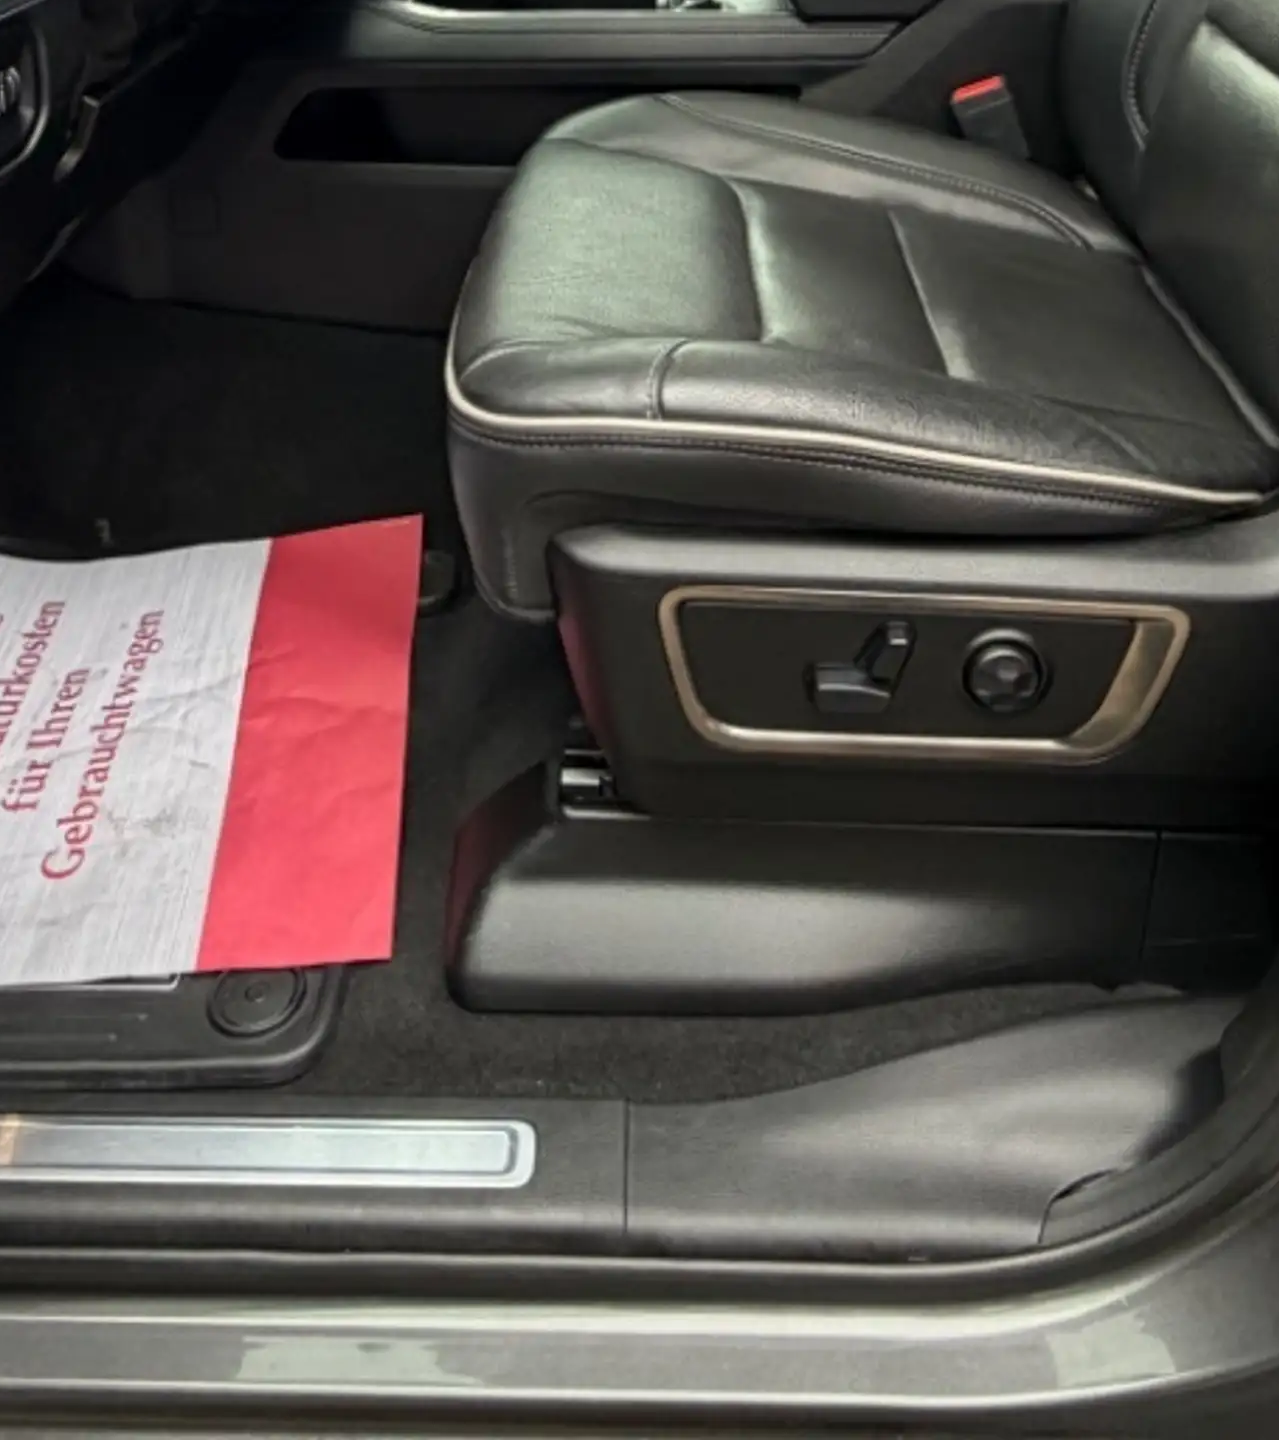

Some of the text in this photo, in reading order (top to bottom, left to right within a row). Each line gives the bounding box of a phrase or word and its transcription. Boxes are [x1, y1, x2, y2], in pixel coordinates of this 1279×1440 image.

[0, 667, 91, 813] für Ihren
[40, 610, 165, 879] Gebrauchtwagen
